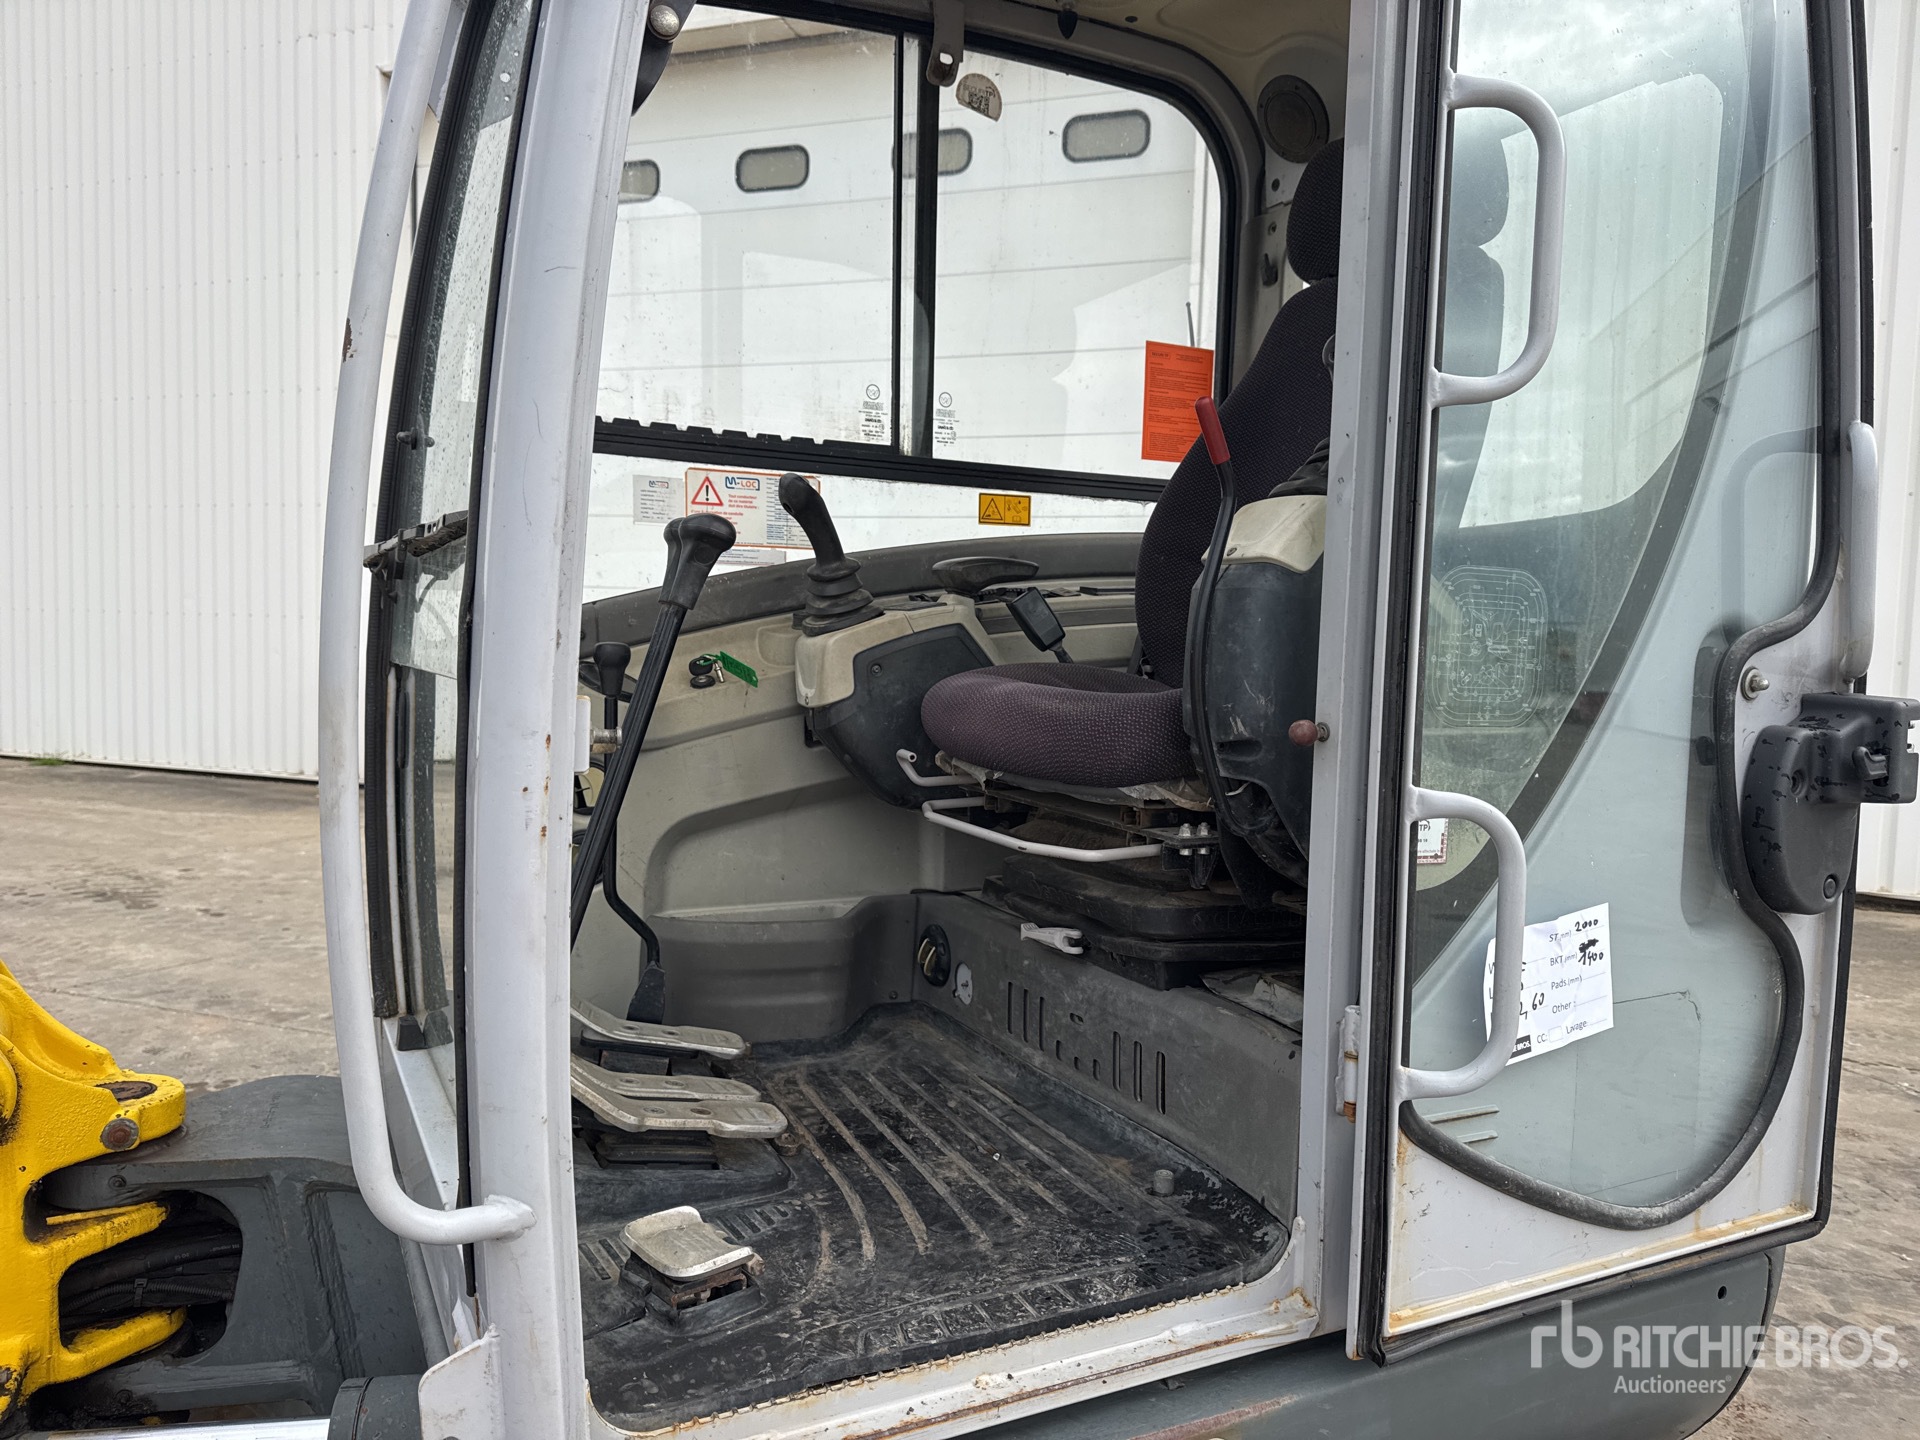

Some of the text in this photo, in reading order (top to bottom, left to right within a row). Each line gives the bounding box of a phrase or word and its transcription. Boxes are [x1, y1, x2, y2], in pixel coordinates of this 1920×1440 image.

[725, 476, 757, 488] M-LOC
[1574, 918, 1599, 932] 2000
[1552, 1001, 1572, 1014] Other
